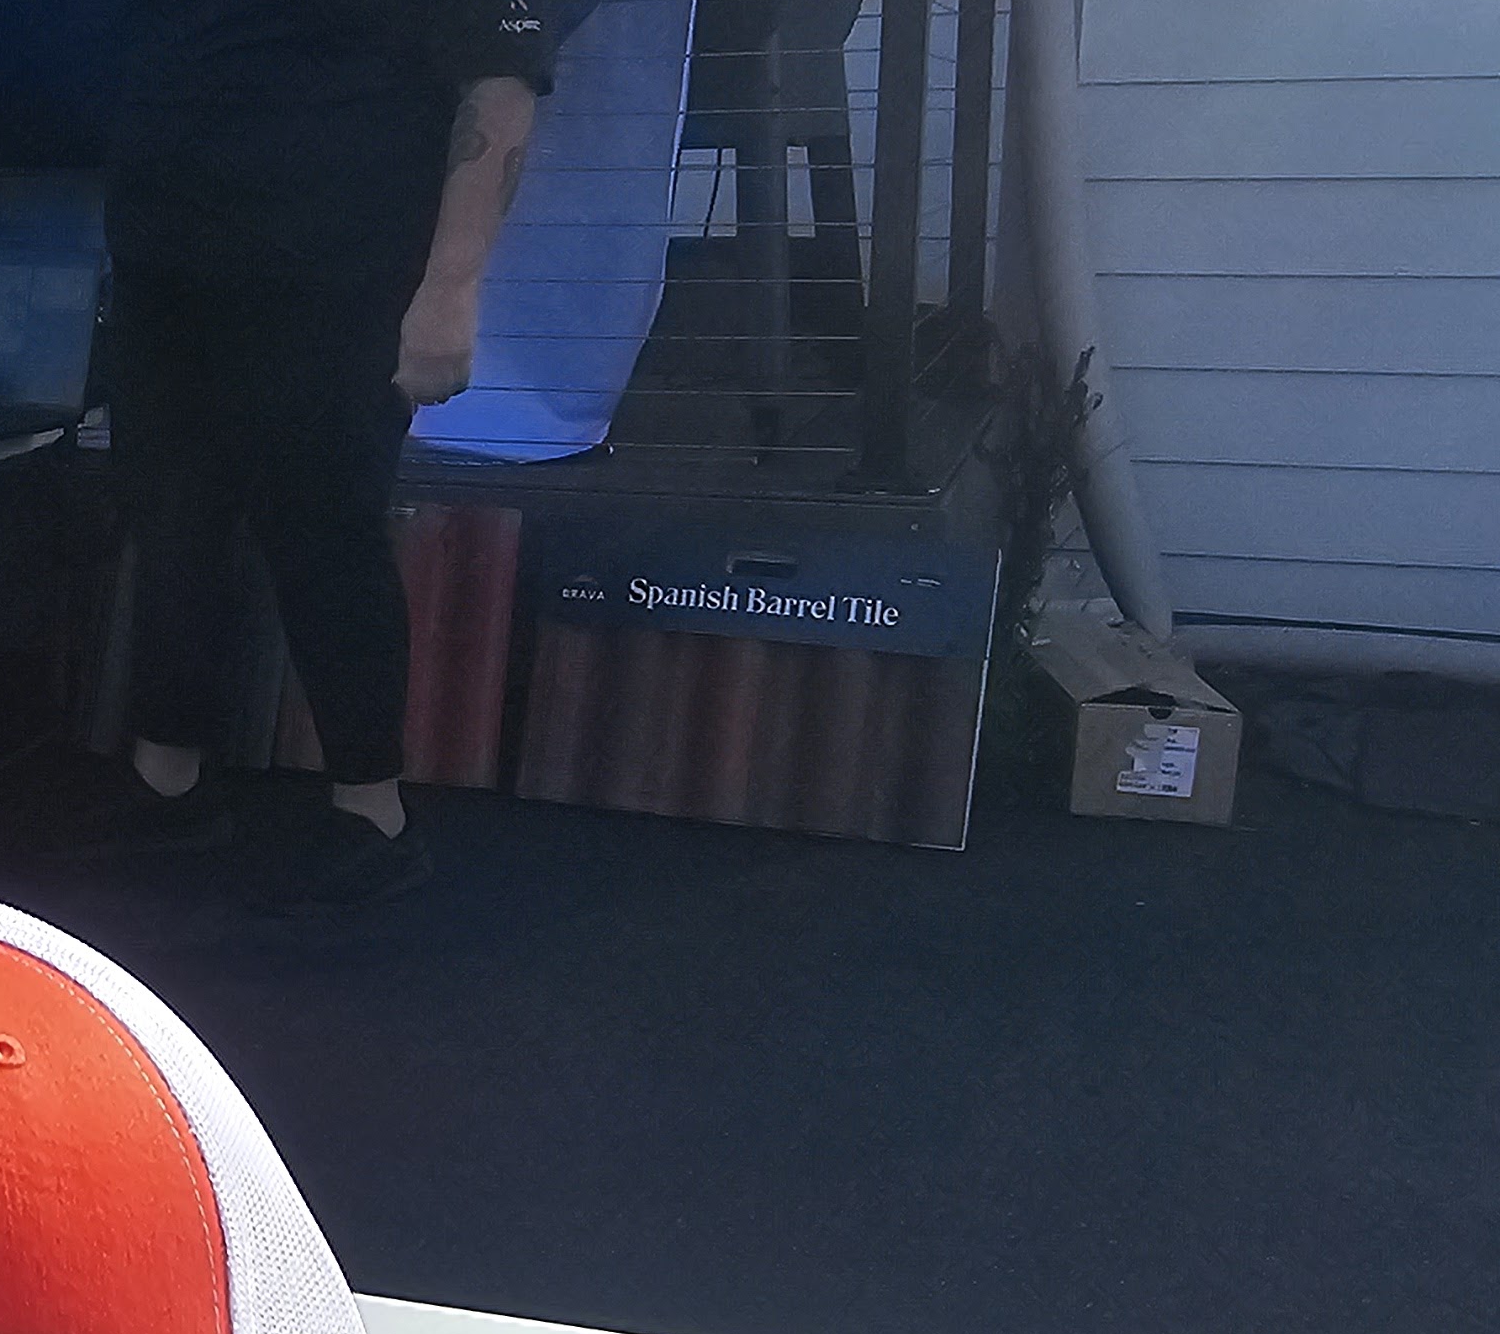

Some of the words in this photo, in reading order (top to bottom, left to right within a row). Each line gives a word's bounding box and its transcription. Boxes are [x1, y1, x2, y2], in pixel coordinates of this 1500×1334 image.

[562, 588, 605, 601] BRAVA
[628, 577, 738, 610] Spanish
[746, 587, 835, 620] Barrel
[842, 596, 899, 626] Tile
